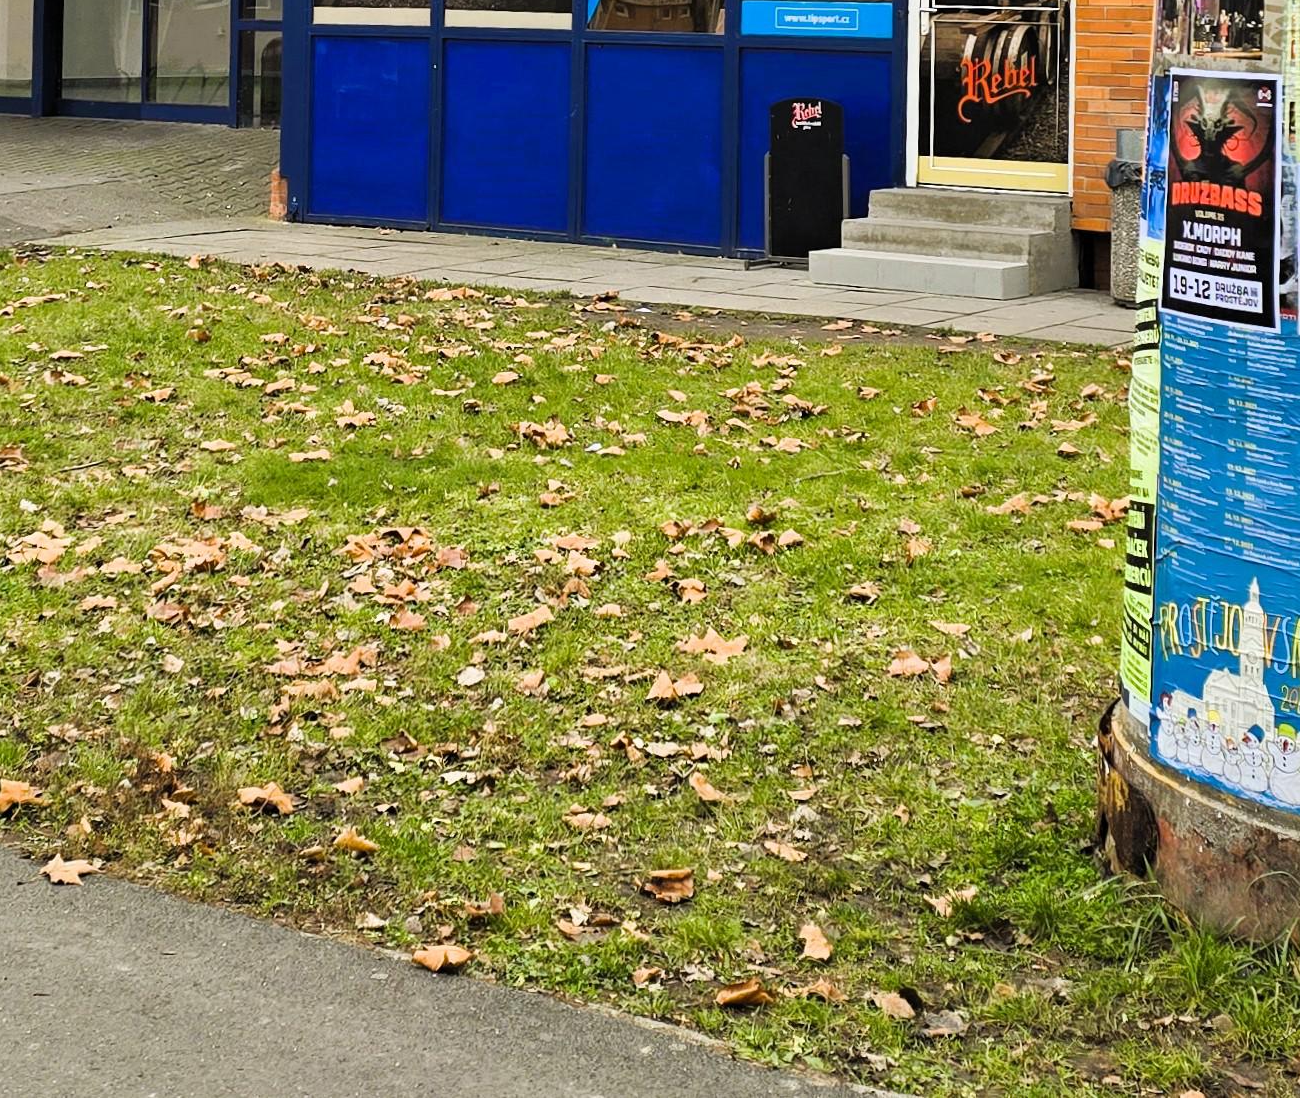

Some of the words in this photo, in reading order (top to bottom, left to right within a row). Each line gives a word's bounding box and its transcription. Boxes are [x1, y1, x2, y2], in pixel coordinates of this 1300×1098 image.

[957, 54, 1038, 123] Rebel
[1172, 179, 1263, 218] DRUŽBASS
[1182, 220, 1243, 248] X.MORPH
[1173, 274, 1211, 300] 19-12
[1215, 280, 1249, 296] DRUŽBA
